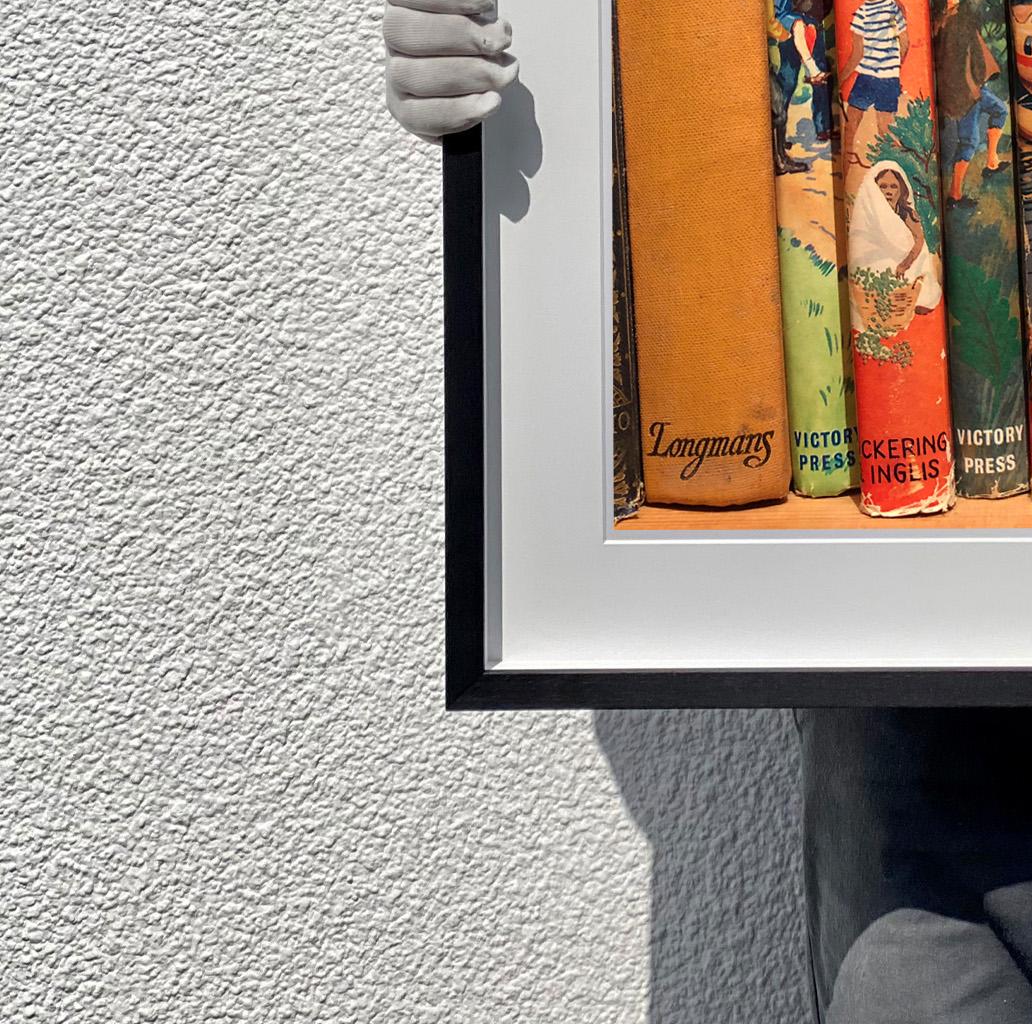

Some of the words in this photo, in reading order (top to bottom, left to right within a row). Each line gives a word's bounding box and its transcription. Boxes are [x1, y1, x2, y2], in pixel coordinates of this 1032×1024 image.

[861, 431, 948, 460] CKERING
[956, 424, 1024, 447] VICTORY
[647, 421, 776, 482] Longmans
[799, 450, 857, 472] PRESS
[963, 453, 1017, 475] PRESS
[871, 458, 940, 485] INGLIS
